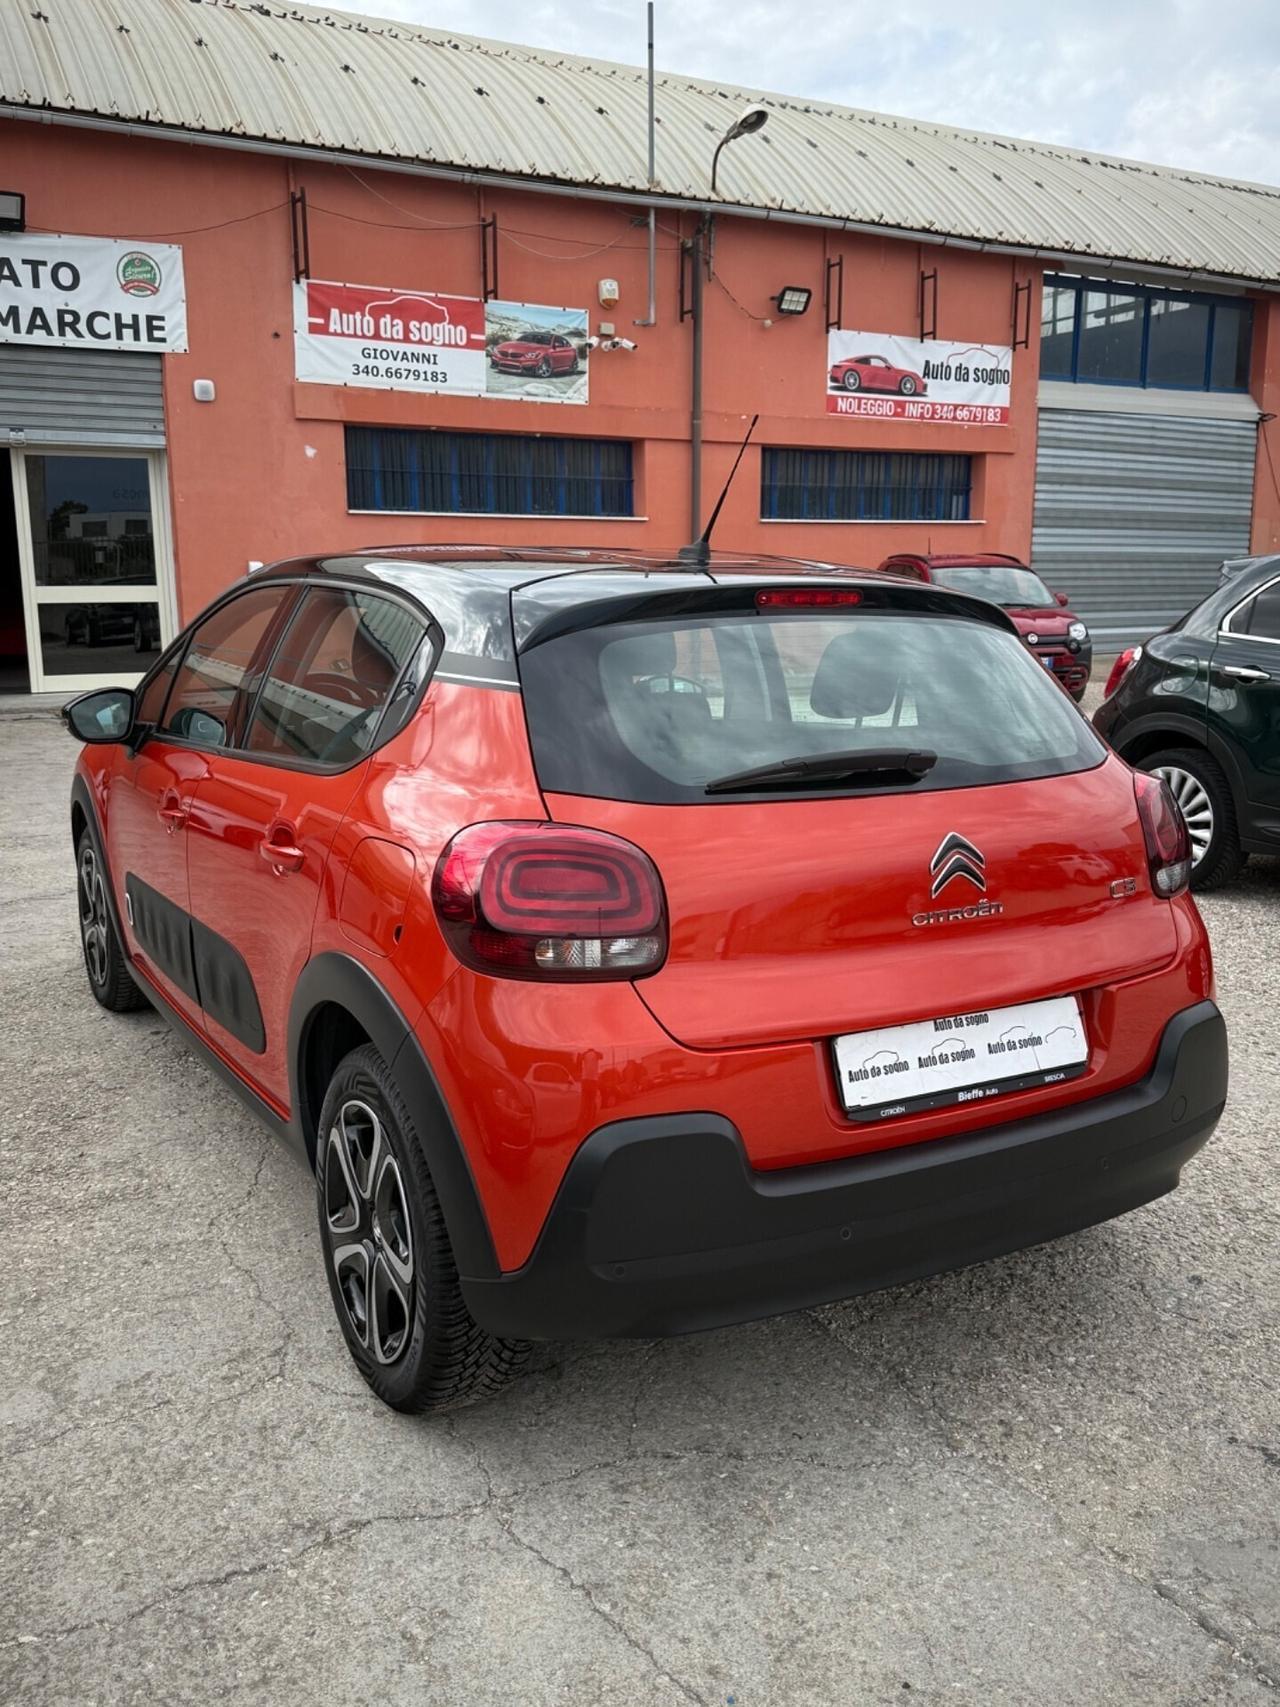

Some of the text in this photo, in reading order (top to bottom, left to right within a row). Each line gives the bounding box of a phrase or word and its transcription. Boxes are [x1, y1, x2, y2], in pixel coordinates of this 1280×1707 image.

[0, 257, 81, 292] ATO
[0, 305, 167, 343] MARCHE
[328, 307, 467, 346] Auto da sogno
[361, 347, 439, 366] GIOVANNI
[352, 363, 448, 383] 340.6679183
[922, 359, 1010, 386] Auto da sogno
[837, 397, 895, 416] NOLEGGIO
[904, 402, 932, 418] INFO
[934, 405, 953, 421] 340
[955, 406, 1001, 422] 6679183
[1110, 876, 1137, 899] C3
[933, 1013, 989, 1033] Auto da sogno
[987, 1041, 1005, 1055] Auto
[1006, 1039, 1017, 1051] da
[918, 1048, 976, 1069] Auto da sogno
[848, 1069, 870, 1083] Auto
[870, 1065, 882, 1078] da
[958, 1088, 984, 1102] Bieffe
